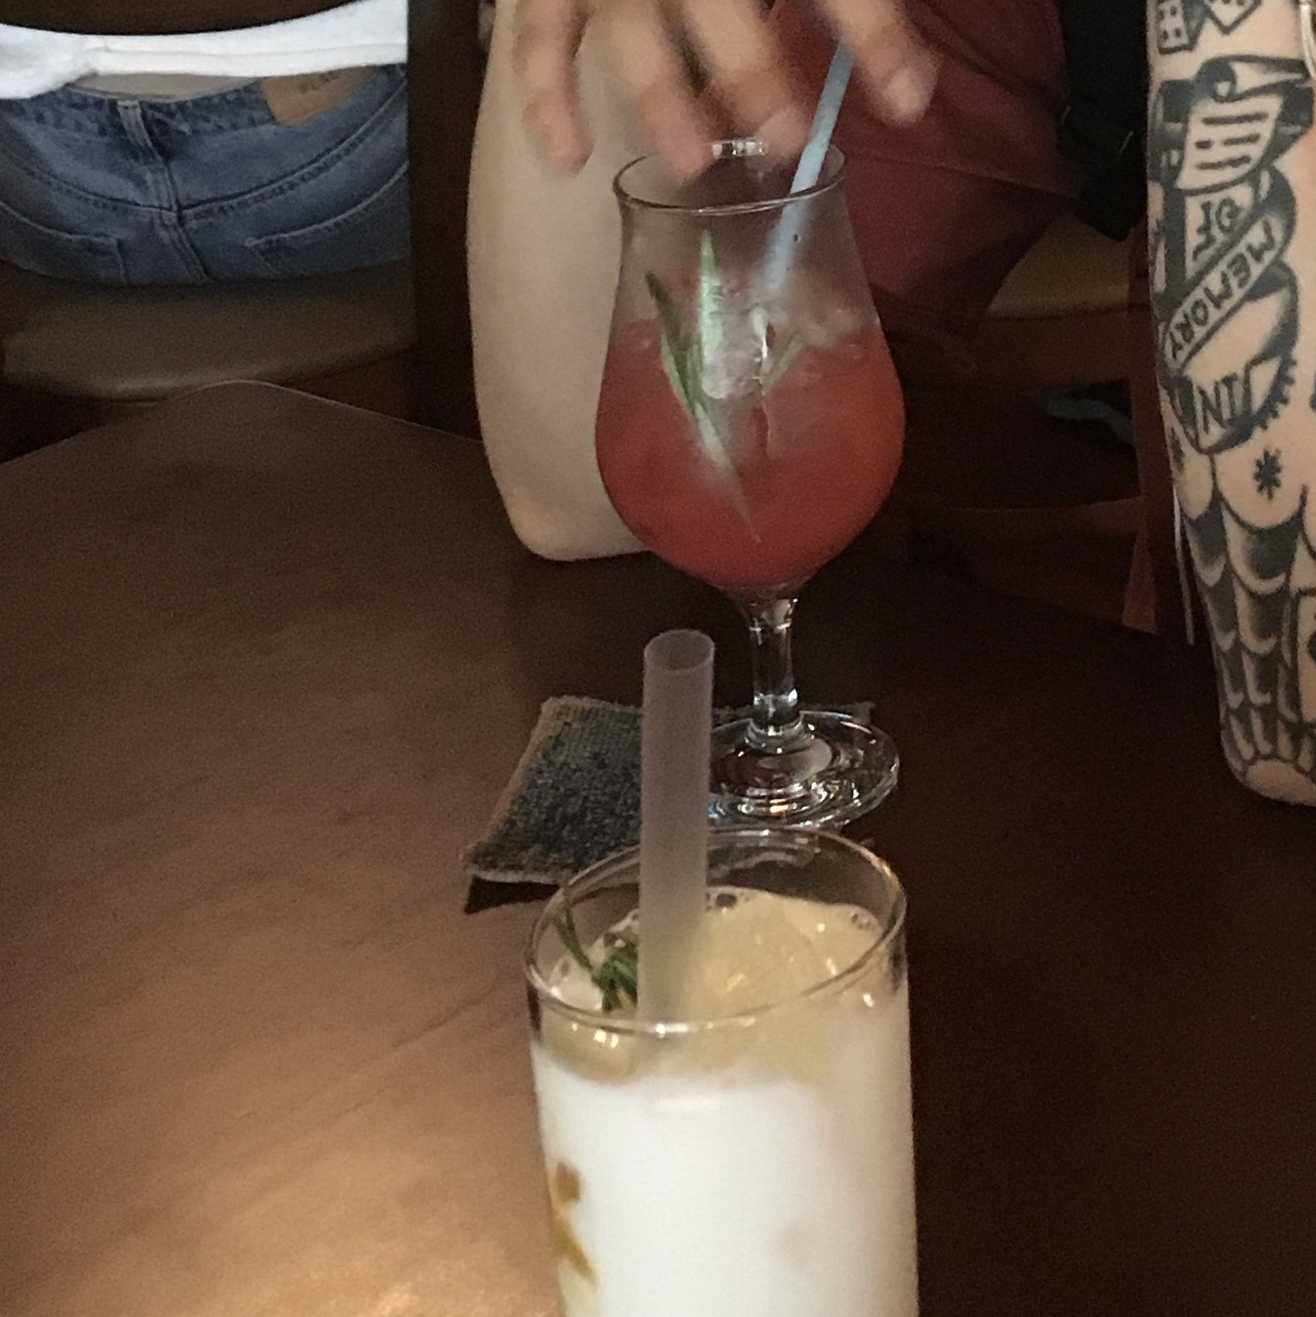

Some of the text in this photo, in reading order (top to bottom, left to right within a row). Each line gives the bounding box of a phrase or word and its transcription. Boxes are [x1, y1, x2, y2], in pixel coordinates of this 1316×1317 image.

[1192, 197, 1241, 261] OF
[1169, 219, 1276, 360] MEMORY
[1198, 371, 1238, 434] IN
